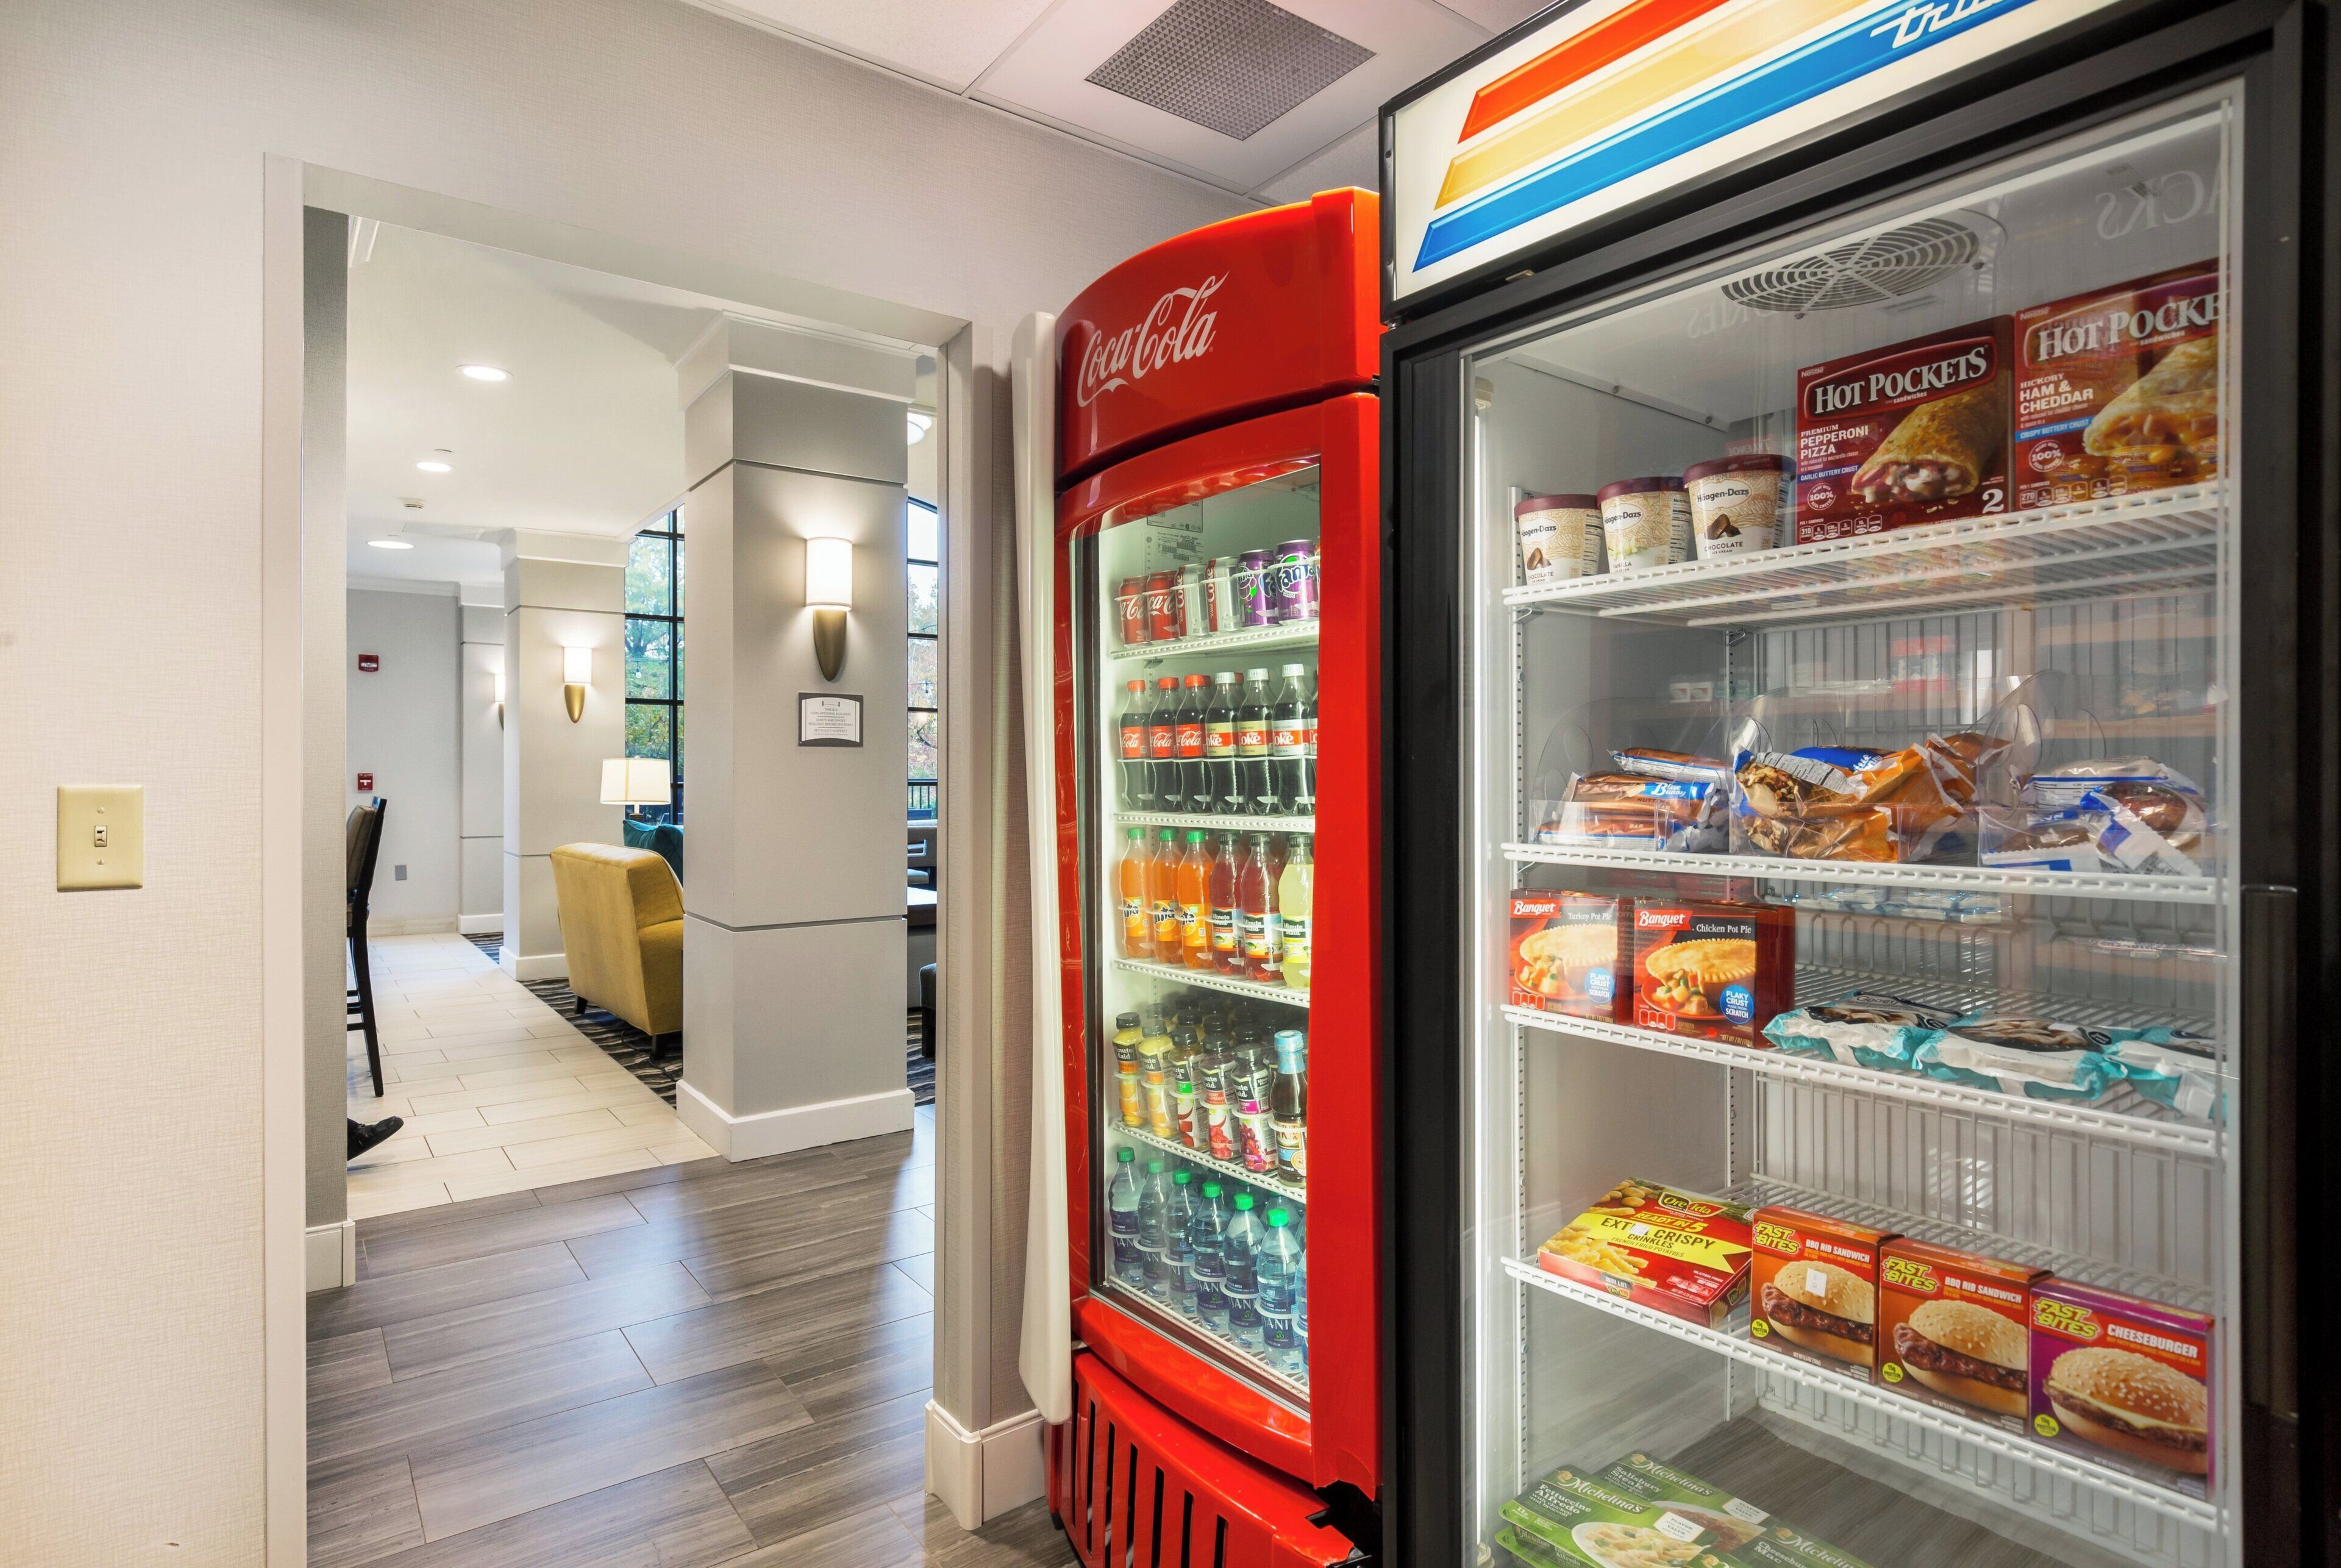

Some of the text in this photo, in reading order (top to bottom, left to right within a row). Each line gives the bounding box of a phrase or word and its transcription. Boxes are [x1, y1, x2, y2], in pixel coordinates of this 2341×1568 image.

[2037, 291, 2219, 362] HOT POCKE
[1077, 271, 1230, 407] Coca-Cola
[2140, 330, 2186, 346] sandwiches
[1801, 366, 1825, 377] Nestlé
[1815, 347, 1987, 414] HOT POCKETS
[2020, 372, 2065, 389] HICKORY
[1893, 392, 1927, 404] sandwiches
[2020, 380, 2072, 402] HAM &
[2020, 388, 2093, 414] CHEDDAR
[1801, 424, 1839, 437] PREMIUM
[1801, 426, 1869, 448] PEPPERONI
[2020, 418, 2090, 439] CRISPY BUTTERY CRUST
[1801, 444, 1836, 459] PIZZA
[2031, 449, 2062, 461] 100%
[1800, 465, 1858, 481] GARLIC BUTTERY CRUST
[1809, 491, 1834, 501] 100%
[1982, 489, 2004, 514] 2
[1704, 541, 1744, 552] CHOCOLATE
[1514, 900, 1556, 916] Banquet
[1568, 912, 1590, 922] Turkey
[1639, 911, 1686, 927] Banquet
[1696, 924, 1725, 933] Chicken
[1589, 989, 1610, 998] SCRATCH
[1726, 991, 1749, 1000] FLAKY
[1726, 998, 1749, 1007] CRUST
[1725, 1008, 1749, 1019] SCRATCH
[1634, 1213, 1673, 1224] READY
[1673, 1219, 1687, 1228] IN
[1684, 1222, 1709, 1233] 5
[1755, 1222, 1794, 1240] FAST
[1601, 1217, 1716, 1249] EXT CRISPY
[1627, 1233, 1674, 1249] CRINKLES
[1611, 1237, 1635, 1246] FRENCH
[1653, 1245, 1684, 1257] POTATOES
[1756, 1234, 1800, 1253] BITES
[1805, 1239, 1819, 1250] BBQ
[1820, 1242, 1831, 1253] RIB
[1833, 1245, 1870, 1263] SANDWICH
[1694, 1270, 1710, 1279] GLUTEN
[1884, 1257, 1929, 1277] FAST
[1605, 1277, 1617, 1285] HERE
[1886, 1270, 1937, 1292] BITES
[1944, 1276, 1961, 1289] BBQ
[1962, 1280, 1976, 1292] RIB
[1977, 1285, 2022, 1304] SANDWICH
[2035, 1298, 2089, 1321] FAST
[2037, 1313, 2098, 1338] BITES
[2107, 1323, 2198, 1359] CHEESEBURGER
[1884, 1370, 1901, 1379] PROTEIN
[1611, 1469, 1644, 1490] Steak
[1616, 1466, 1662, 1493] Salisbury
[1532, 1493, 1572, 1516] with chicken
[1534, 1489, 1580, 1514] Alfredo
[1539, 1483, 1592, 1513] Fettuccine
[1558, 1478, 1644, 1514] Michelina's
[1529, 1495, 1569, 1517] and broccoli
[1667, 1525, 1685, 1535] VALUE
[1670, 1517, 1693, 1530] FLAVOR
[1754, 1545, 1782, 1564] Mac
[1758, 1541, 1808, 1568] Cheesebur
[1775, 1535, 1855, 1568] Michelin
